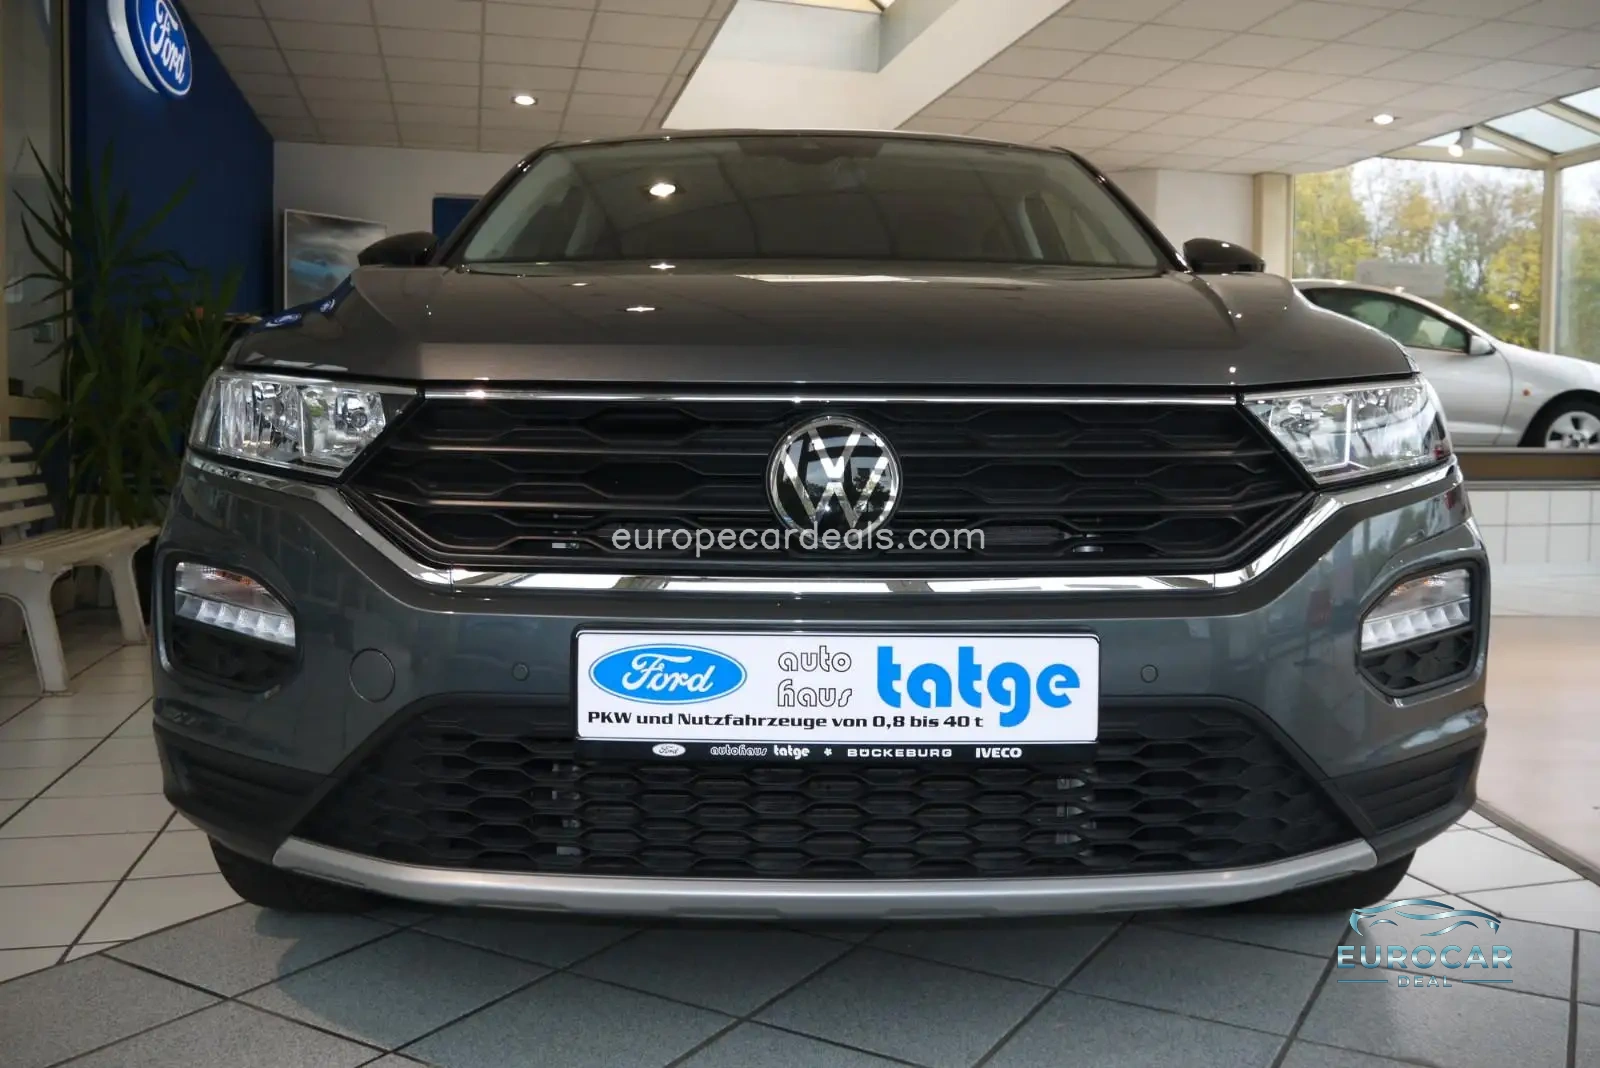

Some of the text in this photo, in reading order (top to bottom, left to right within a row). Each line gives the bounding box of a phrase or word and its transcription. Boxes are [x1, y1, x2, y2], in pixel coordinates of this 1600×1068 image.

[149, 0, 186, 84] Ford
[621, 652, 716, 693] Ford
[777, 645, 852, 673] auto
[777, 678, 853, 708] haus
[877, 646, 1081, 728] tatge
[588, 711, 984, 730] PKW und Nutzfahrzeuge von 0,8 bis 40 t
[710, 743, 810, 760] autohaus tatge
[975, 747, 1023, 758] IVECO
